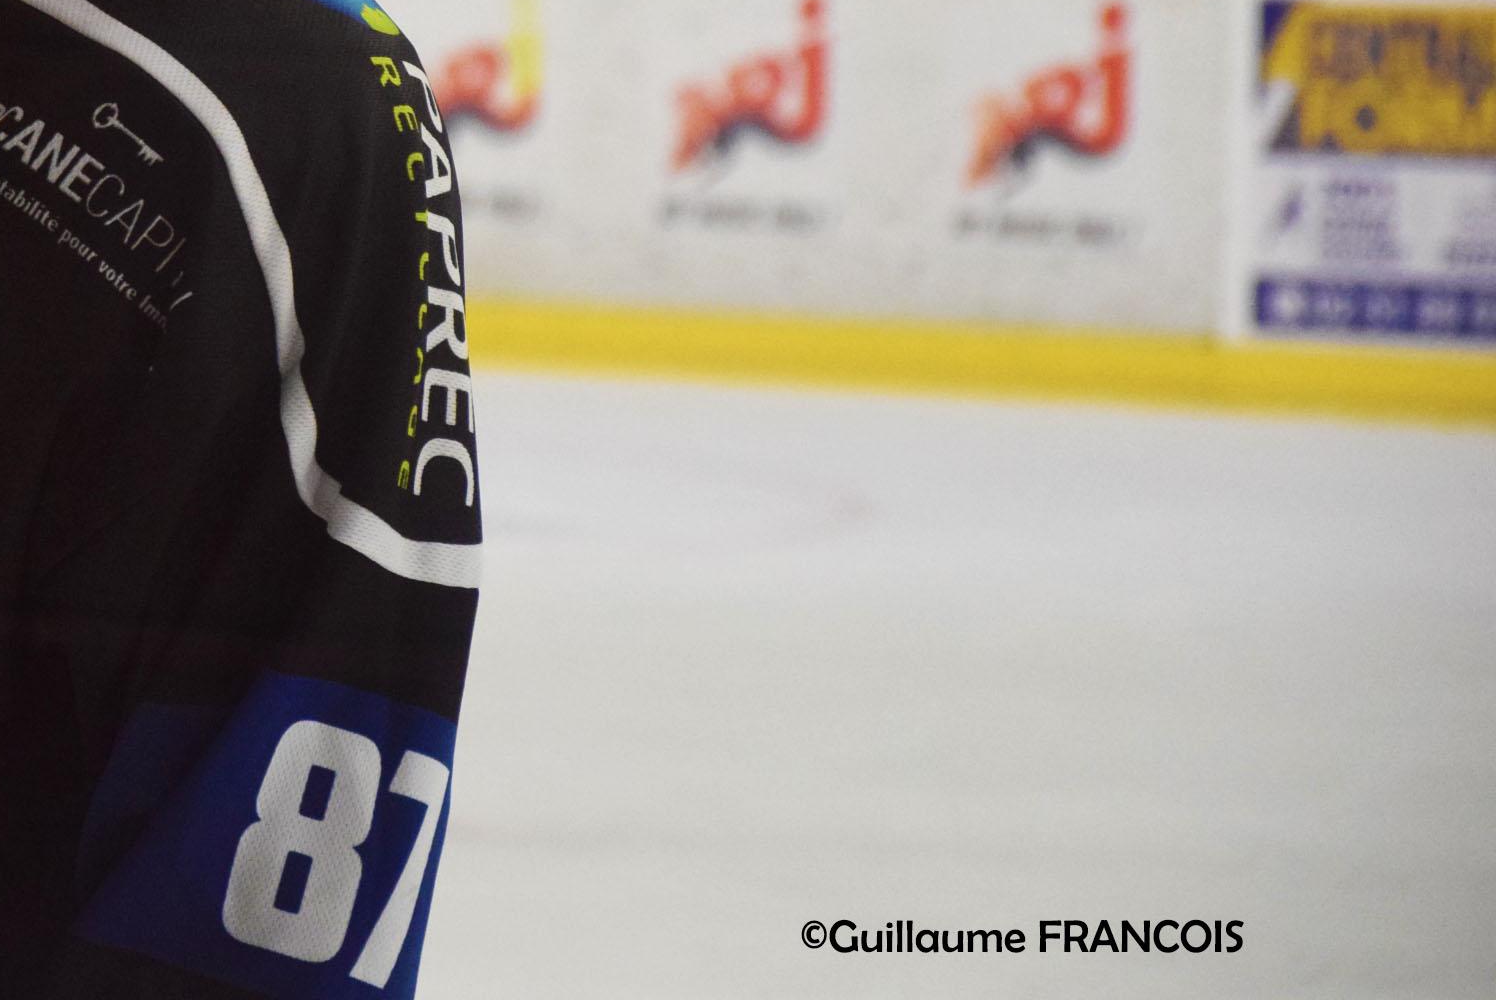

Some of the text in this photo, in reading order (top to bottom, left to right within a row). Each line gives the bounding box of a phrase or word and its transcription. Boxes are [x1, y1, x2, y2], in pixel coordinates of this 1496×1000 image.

[58, 229, 98, 263] pour
[98, 259, 138, 301] votre
[402, 60, 475, 507] PAPREC
[220, 719, 451, 990] 87
